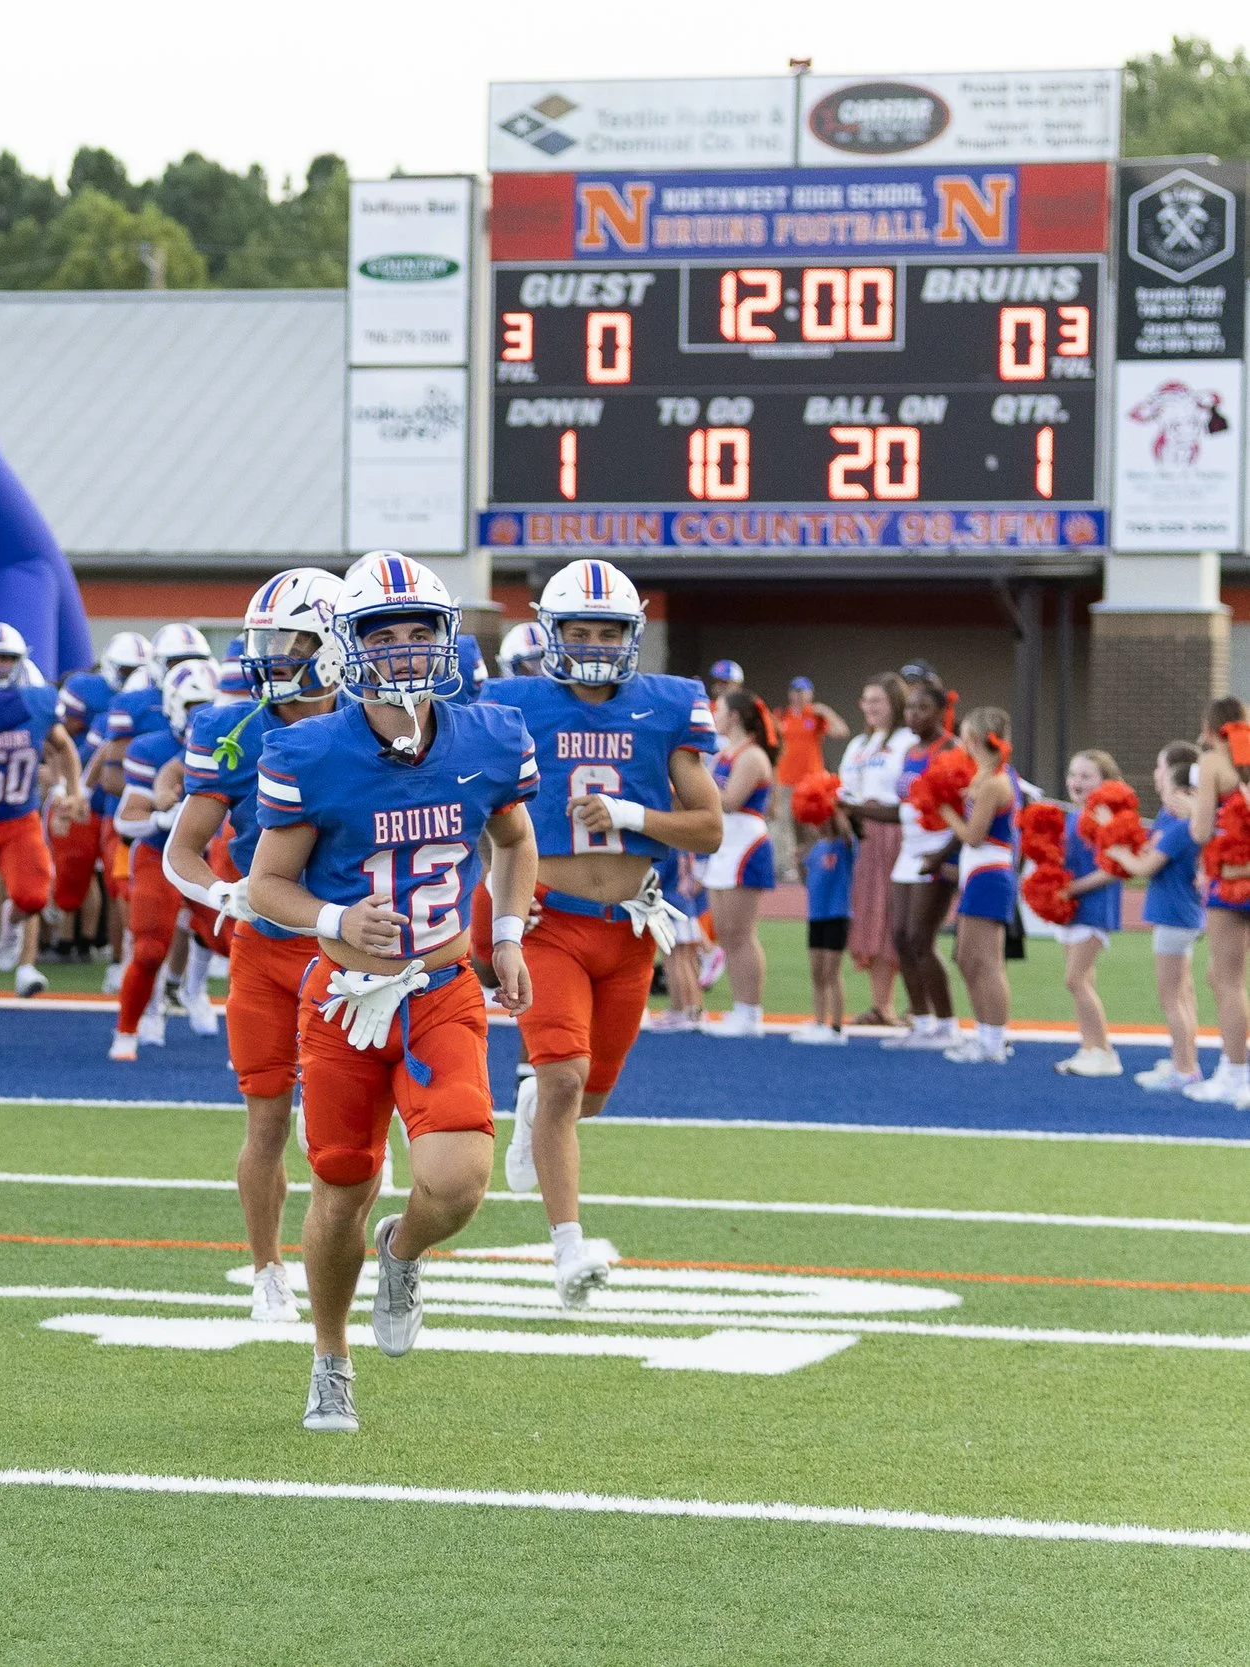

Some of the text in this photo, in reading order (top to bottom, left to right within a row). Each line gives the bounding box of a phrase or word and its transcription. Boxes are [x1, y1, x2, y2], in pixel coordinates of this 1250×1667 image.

[577, 182, 654, 253] N
[661, 182, 926, 212] NORTHWEST HIGH SCHOOL
[933, 173, 1015, 246] N
[652, 211, 930, 249] BRUINS FOOTBALL
[519, 272, 656, 307] GUEST
[719, 268, 894, 342] 12:00
[920, 265, 1082, 303] BRUINS
[502, 312, 533, 361] 3
[586, 311, 632, 385] 0
[999, 307, 1046, 381] 0
[1056, 305, 1090, 356] 3
[505, 397, 605, 427] DOWN
[657, 396, 754, 426] TO GO
[803, 394, 949, 425] BALL ON
[991, 394, 1070, 425] QTR.
[559, 429, 577, 500] 1
[688, 427, 750, 500] 10
[828, 427, 920, 500] 20
[1035, 426, 1054, 499] 1
[526, 512, 663, 544] BRUIN
[672, 511, 887, 544] COUNTRY
[385, 595, 419, 604] Riddell
[556, 732, 634, 759] BRUINS
[374, 803, 463, 844] BRUINS
[360, 841, 471, 959] 12
